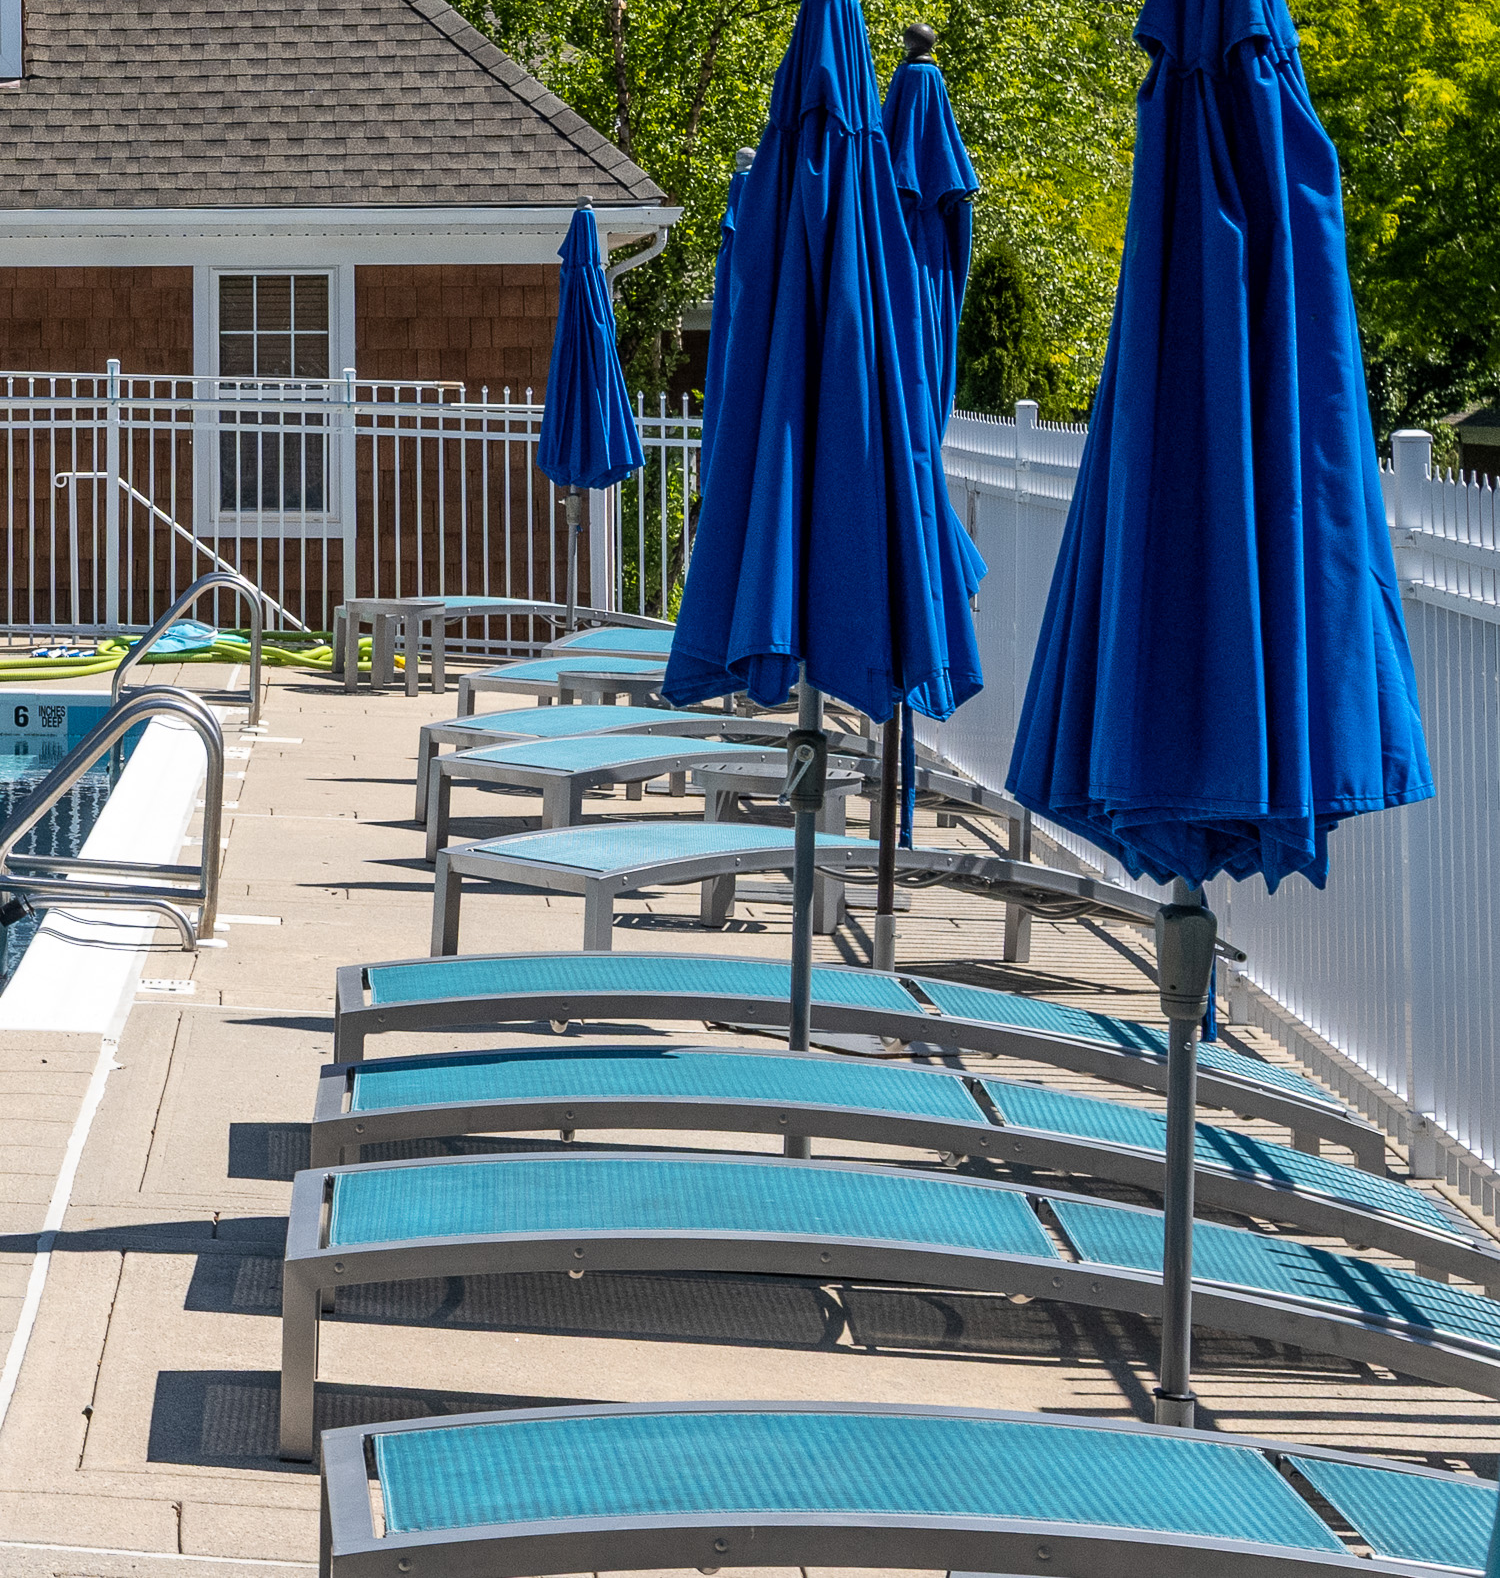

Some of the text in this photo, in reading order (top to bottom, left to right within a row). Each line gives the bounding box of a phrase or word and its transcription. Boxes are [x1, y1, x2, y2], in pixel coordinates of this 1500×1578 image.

[14, 706, 29, 727] 6
[38, 705, 66, 717] INCHES
[42, 716, 63, 728] DEEP
